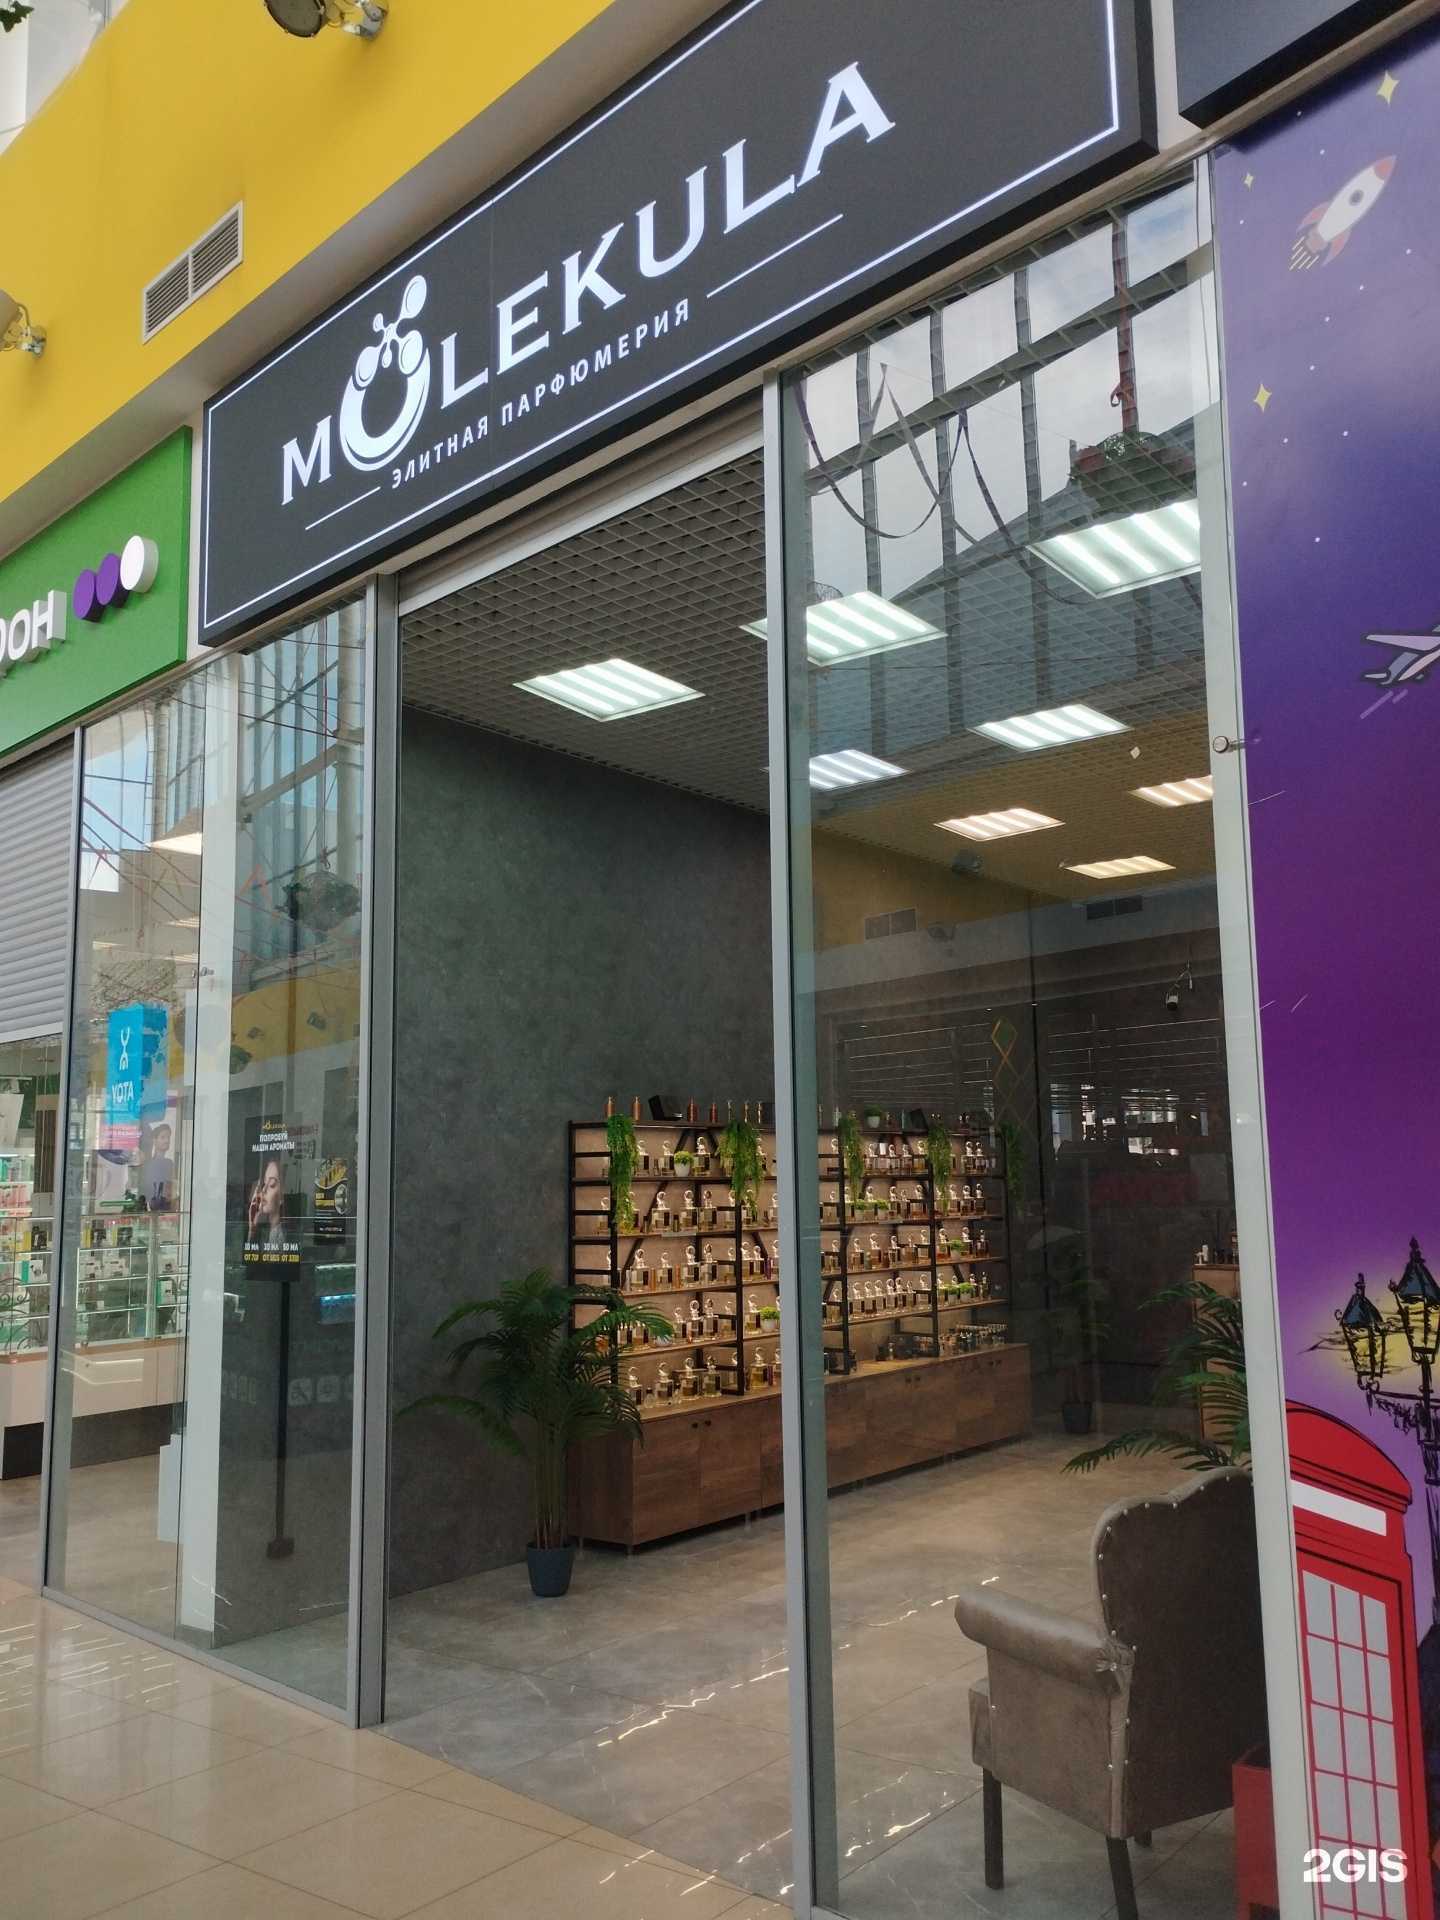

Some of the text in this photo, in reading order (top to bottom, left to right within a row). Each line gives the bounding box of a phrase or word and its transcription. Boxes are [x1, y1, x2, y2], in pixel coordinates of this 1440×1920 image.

[281, 61, 897, 506] MOLEKULA
[391, 298, 691, 490] ЭЛИТНАЯ ПАРФЮМЕРИЯ
[111, 1081, 134, 1105] YOTA
[268, 1140, 295, 1151] АРОМАТЫ
